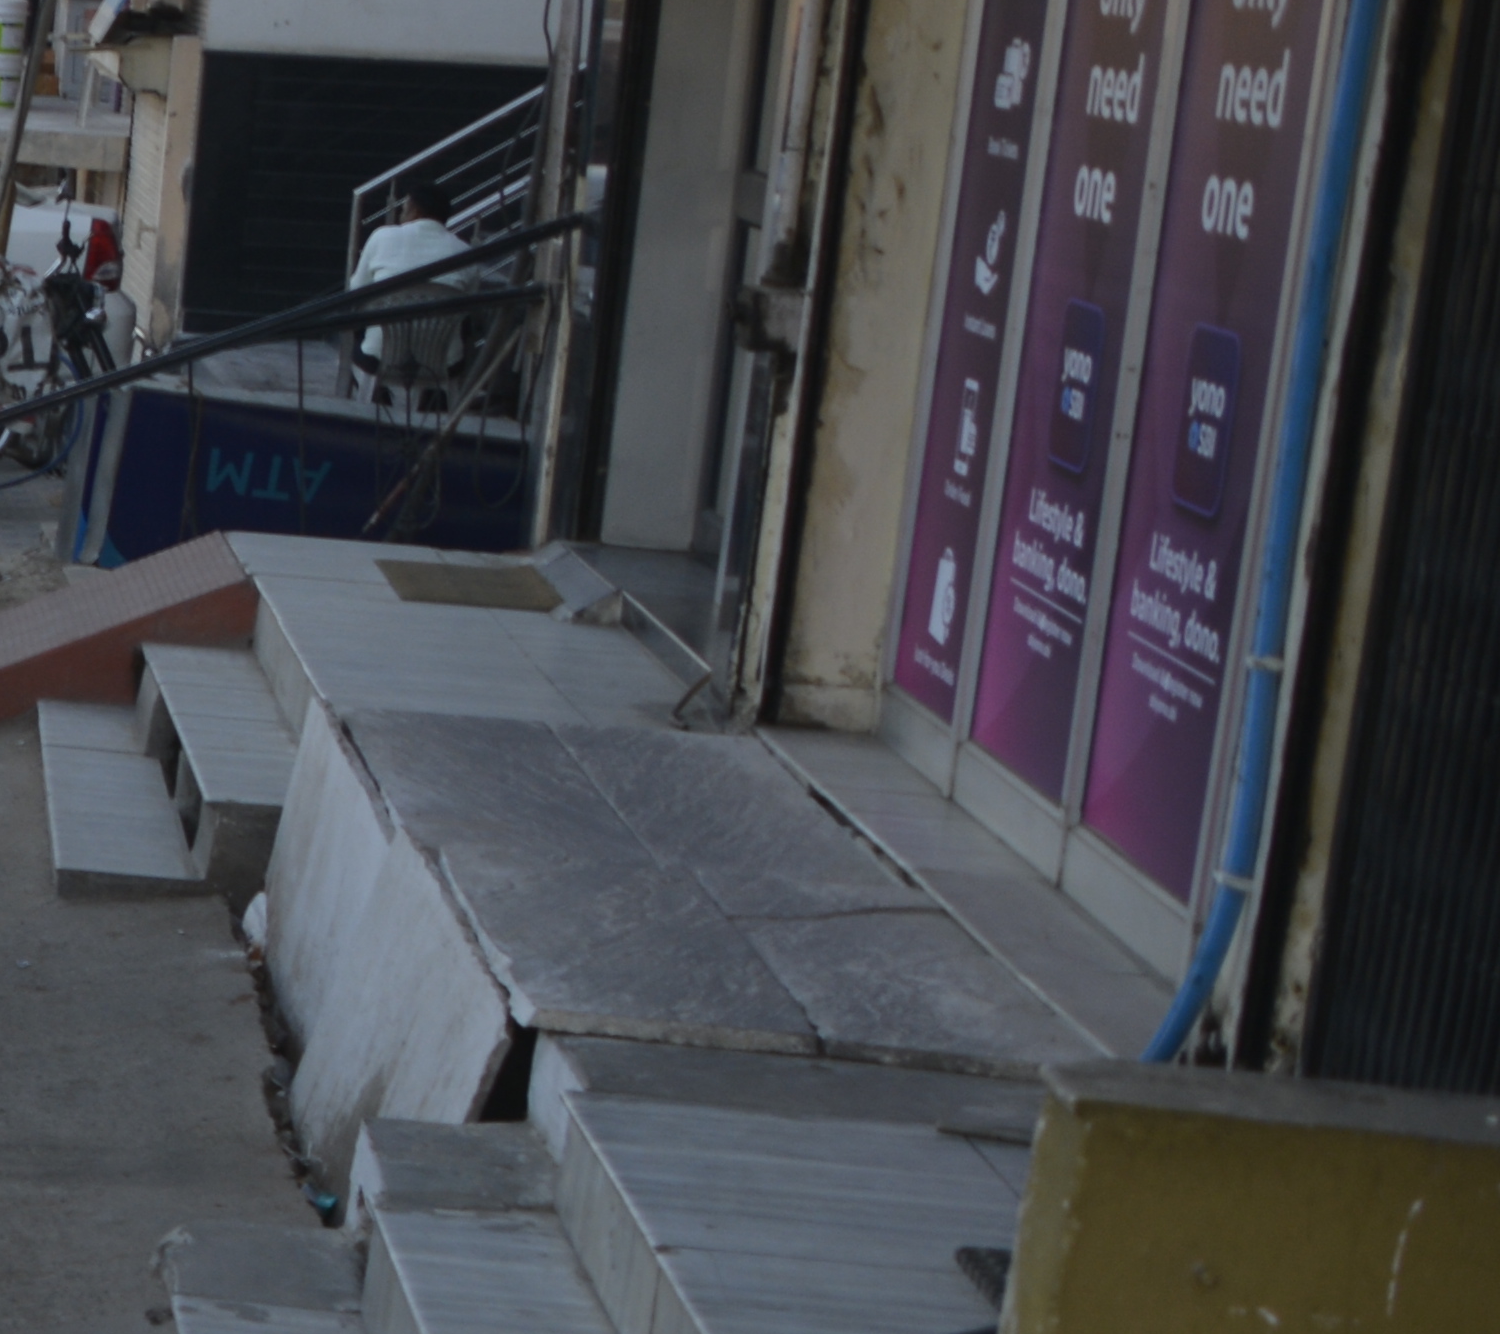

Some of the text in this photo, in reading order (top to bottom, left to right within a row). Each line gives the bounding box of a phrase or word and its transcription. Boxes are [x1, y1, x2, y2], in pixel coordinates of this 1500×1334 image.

[1086, 52, 1146, 124] need
[1214, 49, 1290, 129] need
[1074, 164, 1116, 224] one
[1202, 173, 1254, 241] one
[1061, 347, 1093, 384] yono
[1187, 377, 1226, 418] yono
[205, 446, 332, 504] ATM
[1028, 487, 1085, 549] Lifestyle &
[1012, 530, 1054, 592] banking,
[1148, 531, 1218, 603] Lifestyle &
[1130, 578, 1183, 649] banking,
